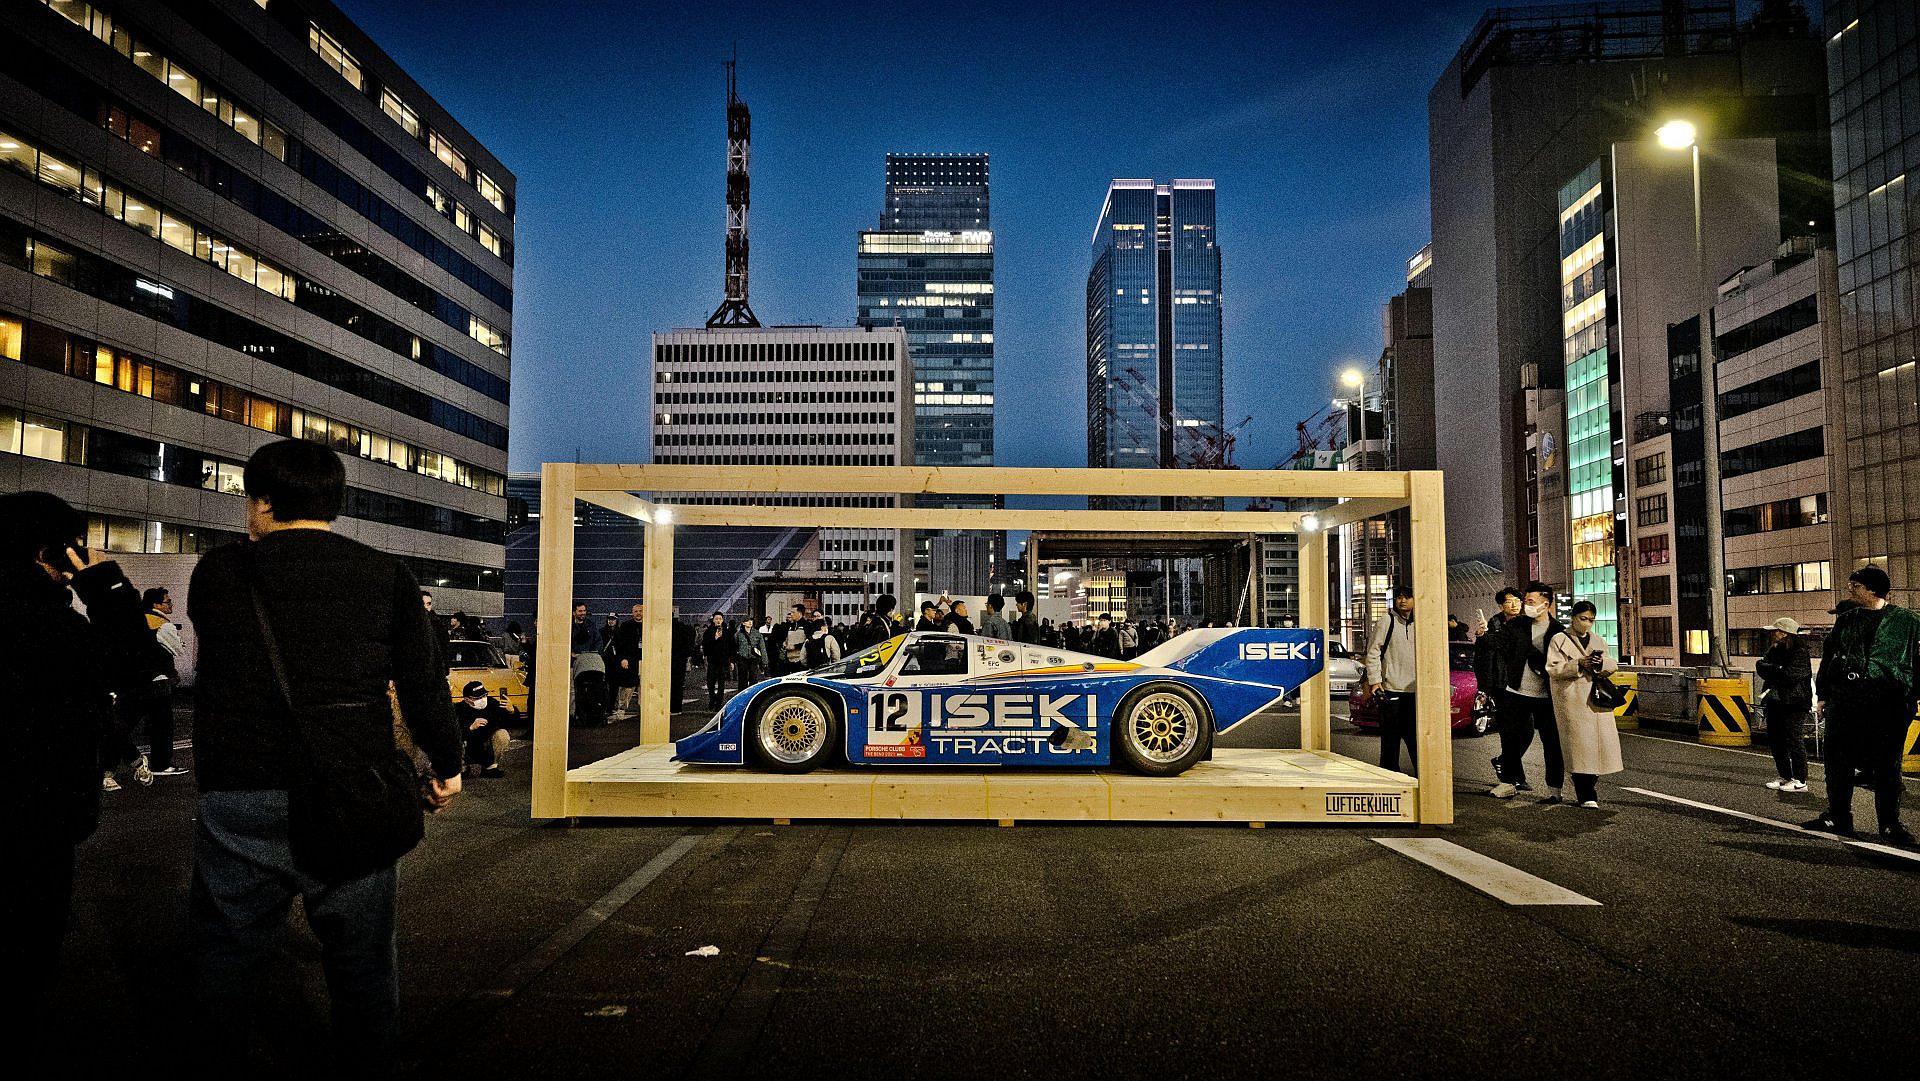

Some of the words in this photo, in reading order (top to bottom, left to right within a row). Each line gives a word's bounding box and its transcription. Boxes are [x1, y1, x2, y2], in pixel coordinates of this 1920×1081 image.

[961, 231, 992, 244] FWD
[1239, 641, 1316, 660] ISEKI
[871, 693, 908, 731] 12
[930, 694, 1098, 729] ISEKI
[1325, 793, 1402, 813] LUFTGEKÜHLT
